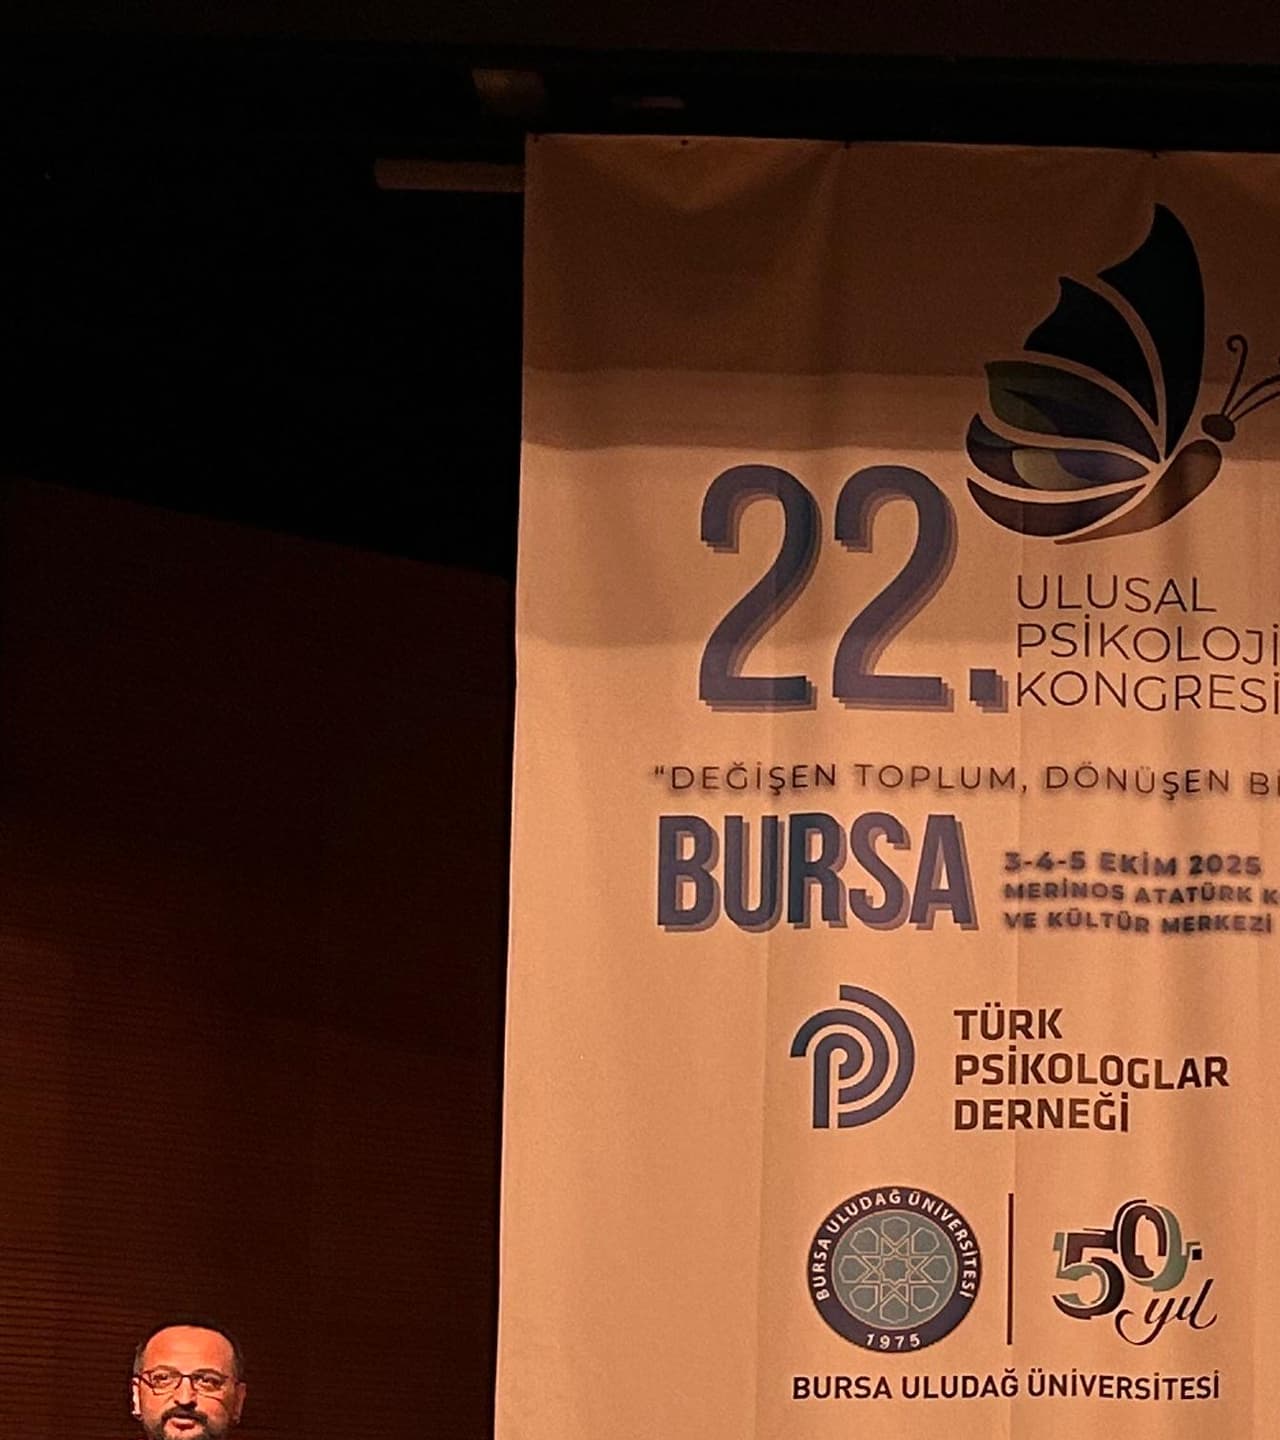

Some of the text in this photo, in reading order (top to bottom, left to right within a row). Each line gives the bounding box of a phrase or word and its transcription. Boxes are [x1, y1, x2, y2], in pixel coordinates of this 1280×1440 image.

[1016, 574, 1217, 614] ULUSAL
[1016, 613, 1280, 666] PSİKOLOJİ
[1015, 669, 1280, 714] KONGRESİ
[854, 763, 1027, 794] TOPLUM,
[1046, 762, 1229, 800] DÖNÜŞEN
[657, 813, 979, 931] BURSA
[1004, 850, 1262, 876] 3-4-5 EKİM 2025
[1004, 877, 1125, 900] MERİNOS
[1134, 880, 1253, 904] ATATÜRK
[1004, 908, 1273, 935] VE KÜLTÜR MERKEZİ
[954, 1001, 1063, 1042] TÜRK
[954, 1044, 1230, 1090] PSİKOLOGLAR
[954, 1091, 1130, 1132] DERNEĞİ
[812, 1238, 832, 1301] BURSA
[825, 1189, 900, 1234] ULUDAĞ
[866, 1333, 921, 1350] 1975
[793, 1368, 1220, 1401] BURSA ULUDAĞ ÜNİVERSİTESİ
